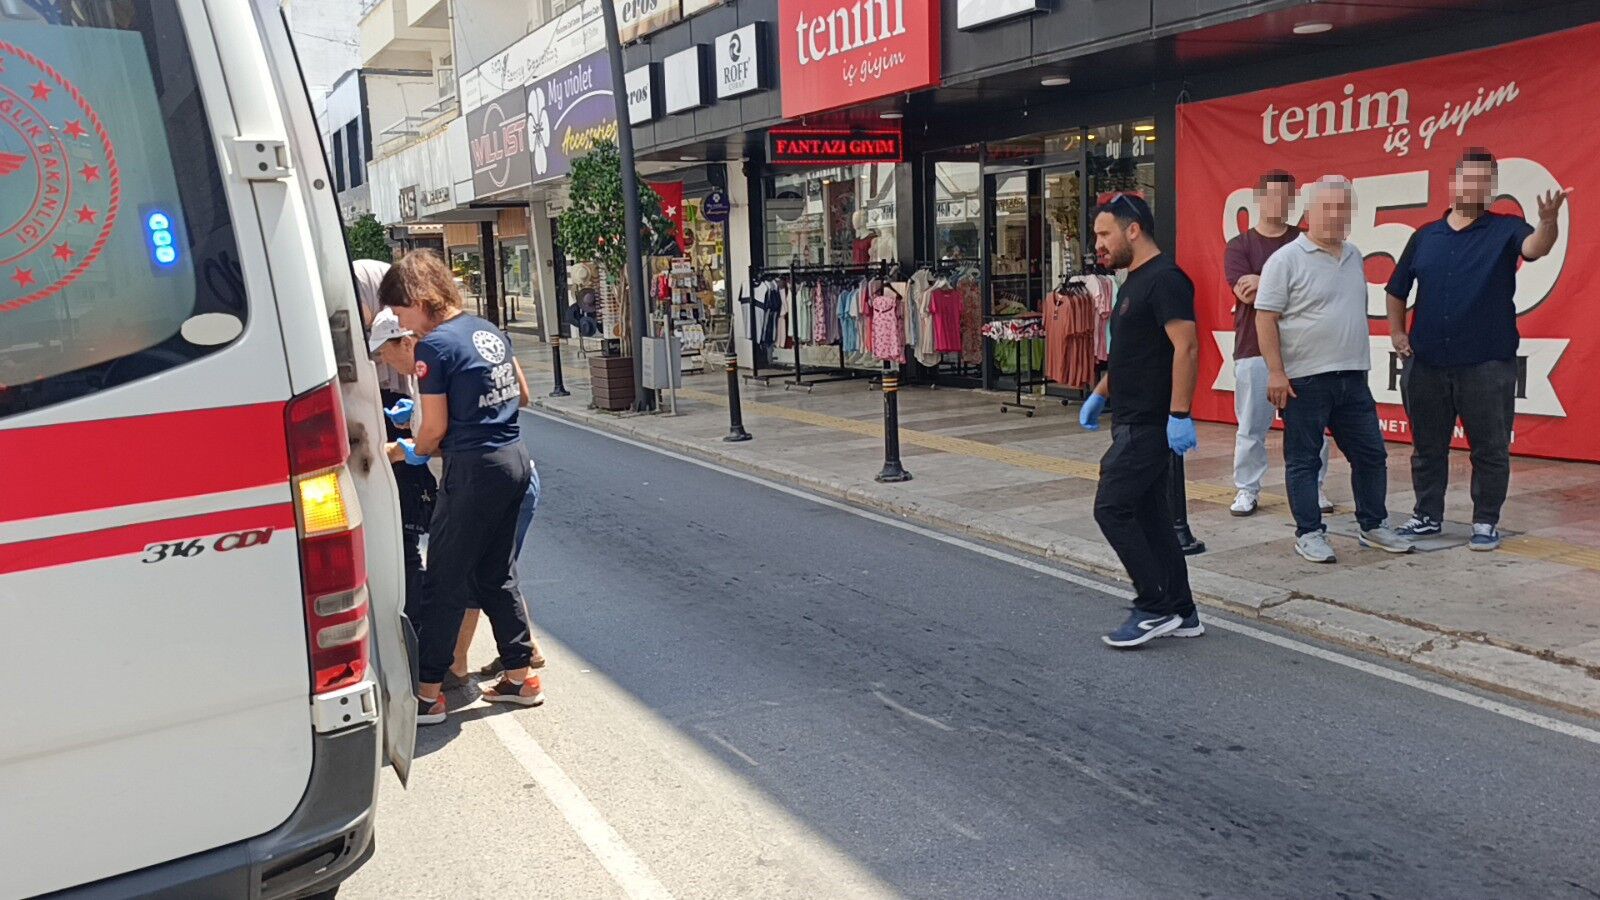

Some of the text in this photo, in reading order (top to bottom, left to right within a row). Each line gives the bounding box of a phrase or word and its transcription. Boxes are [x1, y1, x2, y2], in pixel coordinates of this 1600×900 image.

[724, 60, 749, 84] ROFF
[860, 47, 906, 82] giyim
[548, 78, 563, 111] My
[564, 64, 593, 99] violet
[628, 85, 648, 106] ros
[1260, 83, 1410, 145] tenim
[1383, 81, 1520, 156] iç giyim
[141, 527, 274, 564] 316 CDI
